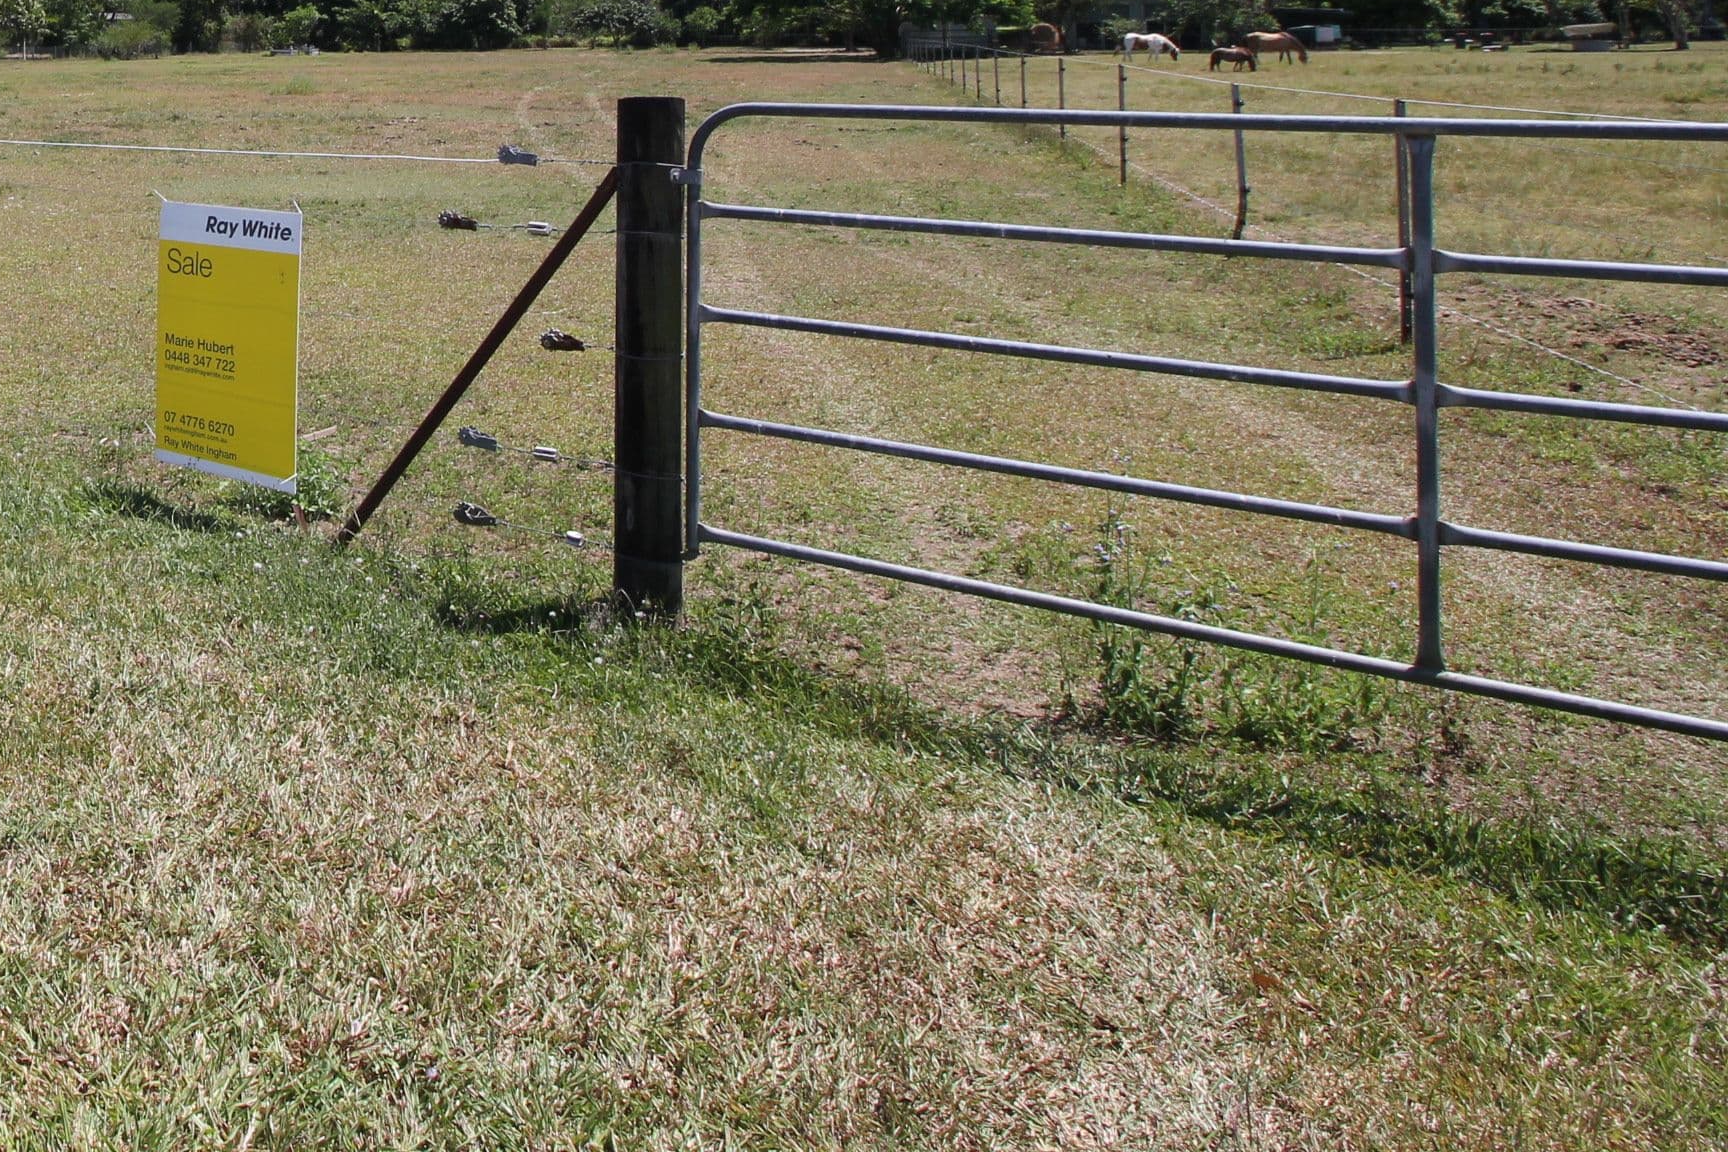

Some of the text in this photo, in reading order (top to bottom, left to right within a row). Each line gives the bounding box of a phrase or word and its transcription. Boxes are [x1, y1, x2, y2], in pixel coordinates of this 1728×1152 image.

[206, 216, 239, 238] Ray
[167, 248, 212, 278] Sale
[165, 332, 234, 355] Marie Hubert
[165, 349, 236, 373] 0448 347 722
[164, 411, 235, 436] 07 4776 6270
[164, 435, 237, 461] Ray White Ingham
